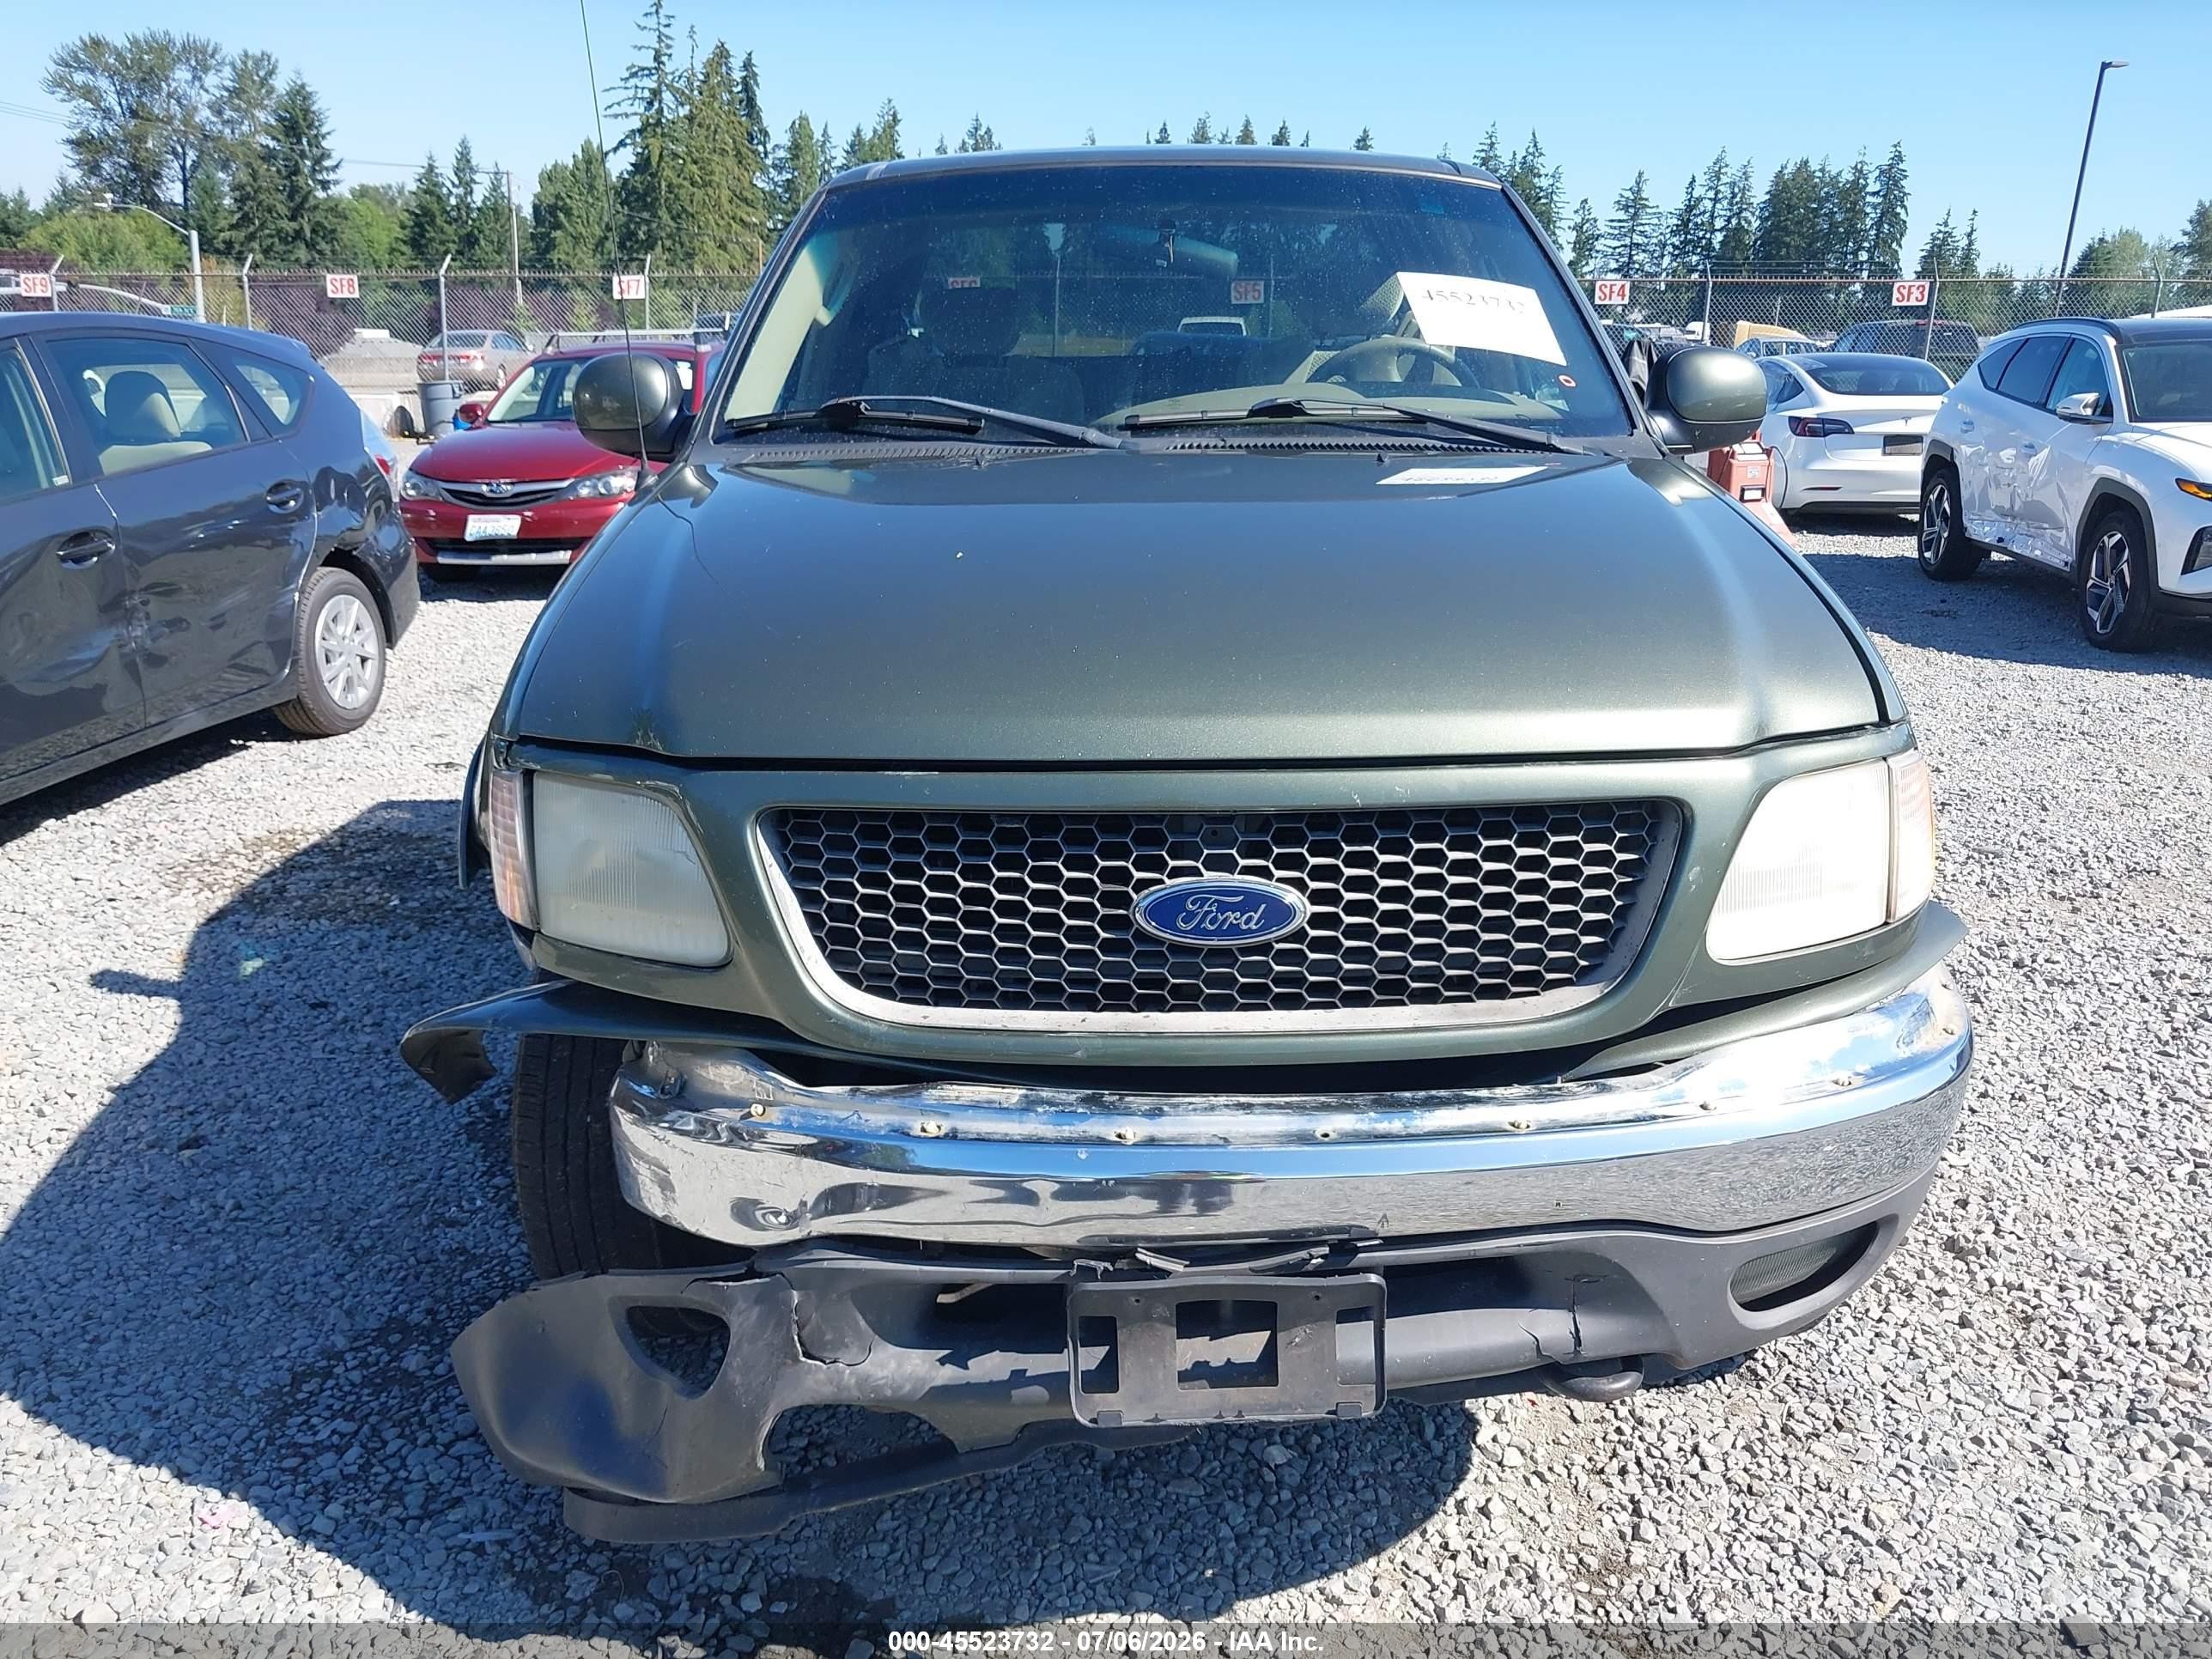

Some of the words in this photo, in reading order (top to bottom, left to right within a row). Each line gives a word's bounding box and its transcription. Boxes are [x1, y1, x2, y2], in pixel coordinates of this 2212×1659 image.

[23, 276, 49, 293] SF9
[330, 277, 355, 295] SF8
[1233, 283, 1261, 301] SF5
[1598, 283, 1626, 301] SF4
[1895, 284, 1926, 302] SF3
[1176, 894, 1267, 930] Ford
